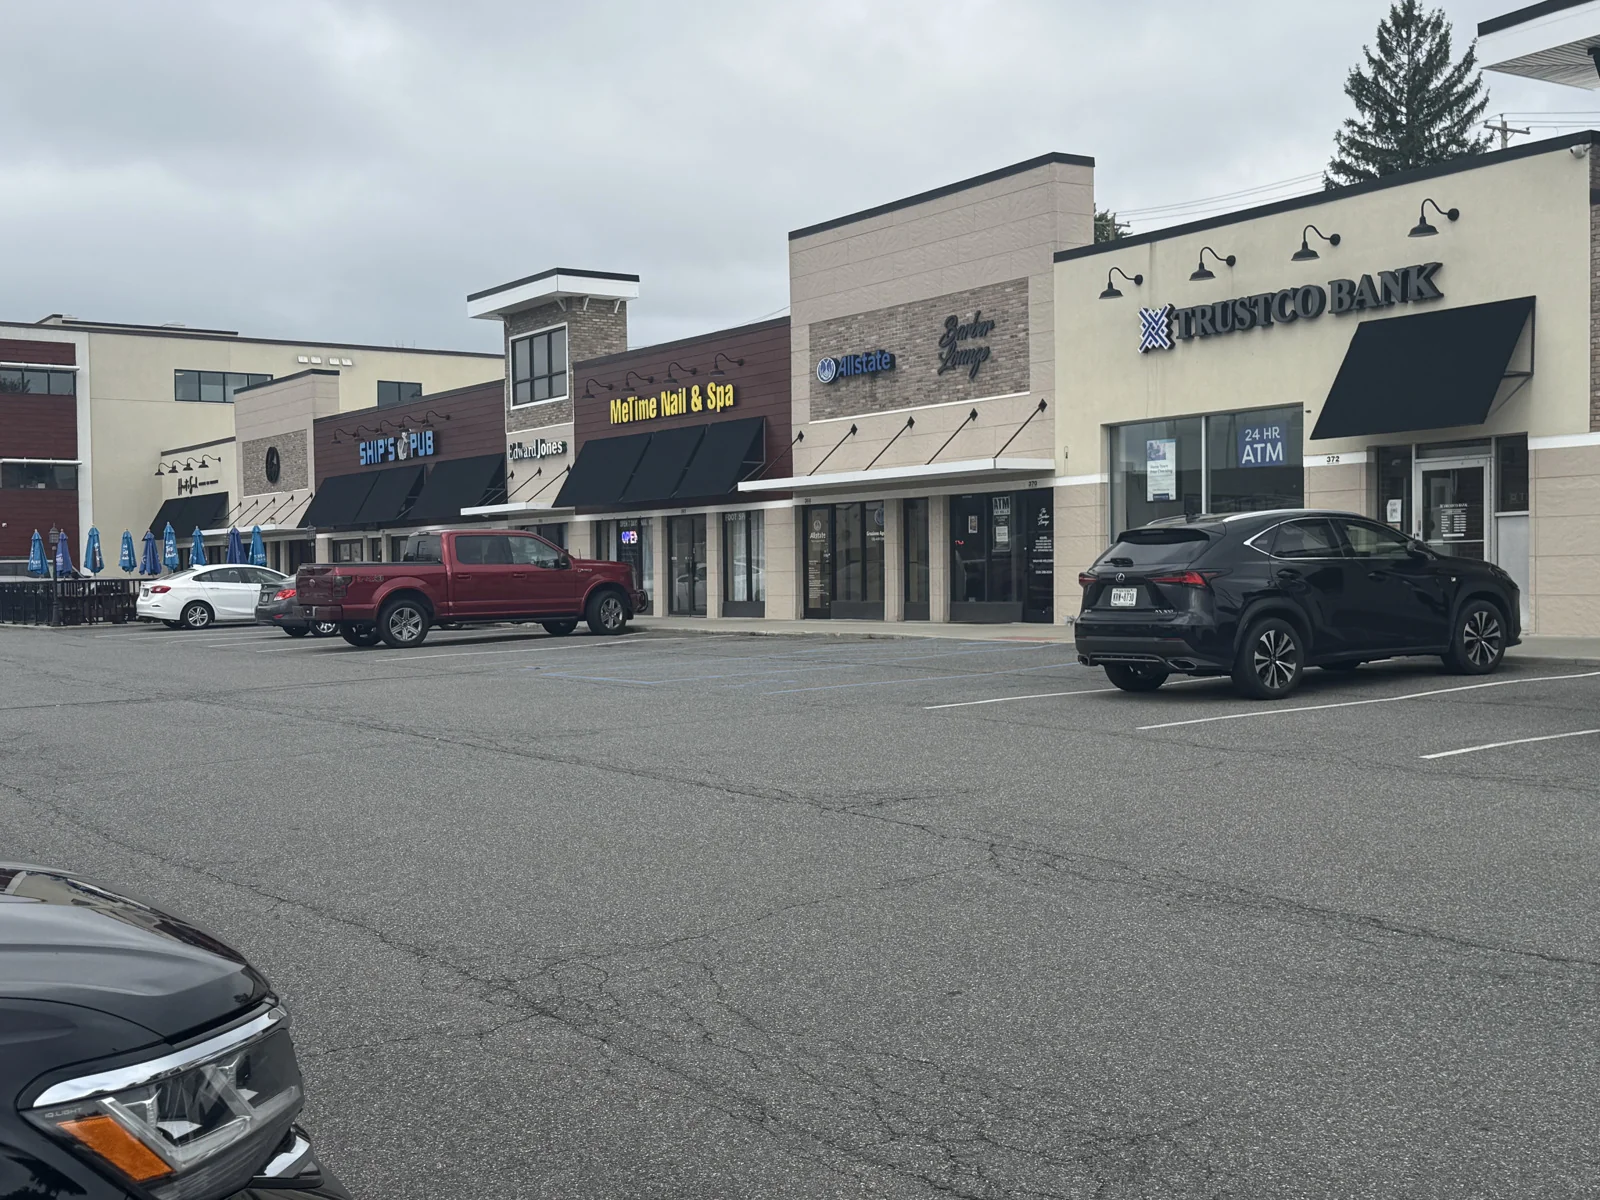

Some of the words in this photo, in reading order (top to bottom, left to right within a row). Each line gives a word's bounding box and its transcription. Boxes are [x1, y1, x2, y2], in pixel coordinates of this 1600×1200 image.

[1172, 284, 1327, 341] TRUSTCO
[1327, 262, 1445, 315] BANK
[938, 310, 995, 348] Barber
[836, 350, 895, 378] Allstate
[937, 342, 991, 381] Lounge
[610, 396, 658, 424] MeTime
[660, 387, 687, 417] Nail
[690, 384, 703, 413] &
[707, 381, 734, 413] Spa
[1245, 428, 1260, 442] 24
[1263, 426, 1281, 440] HR
[360, 436, 396, 467] SHIP'S
[409, 430, 435, 459] PUB
[508, 439, 537, 460] Edward
[537, 438, 564, 459] Jones
[1241, 441, 1283, 464] ATM
[1326, 455, 1340, 463] 372
[993, 497, 1010, 511] ATM
